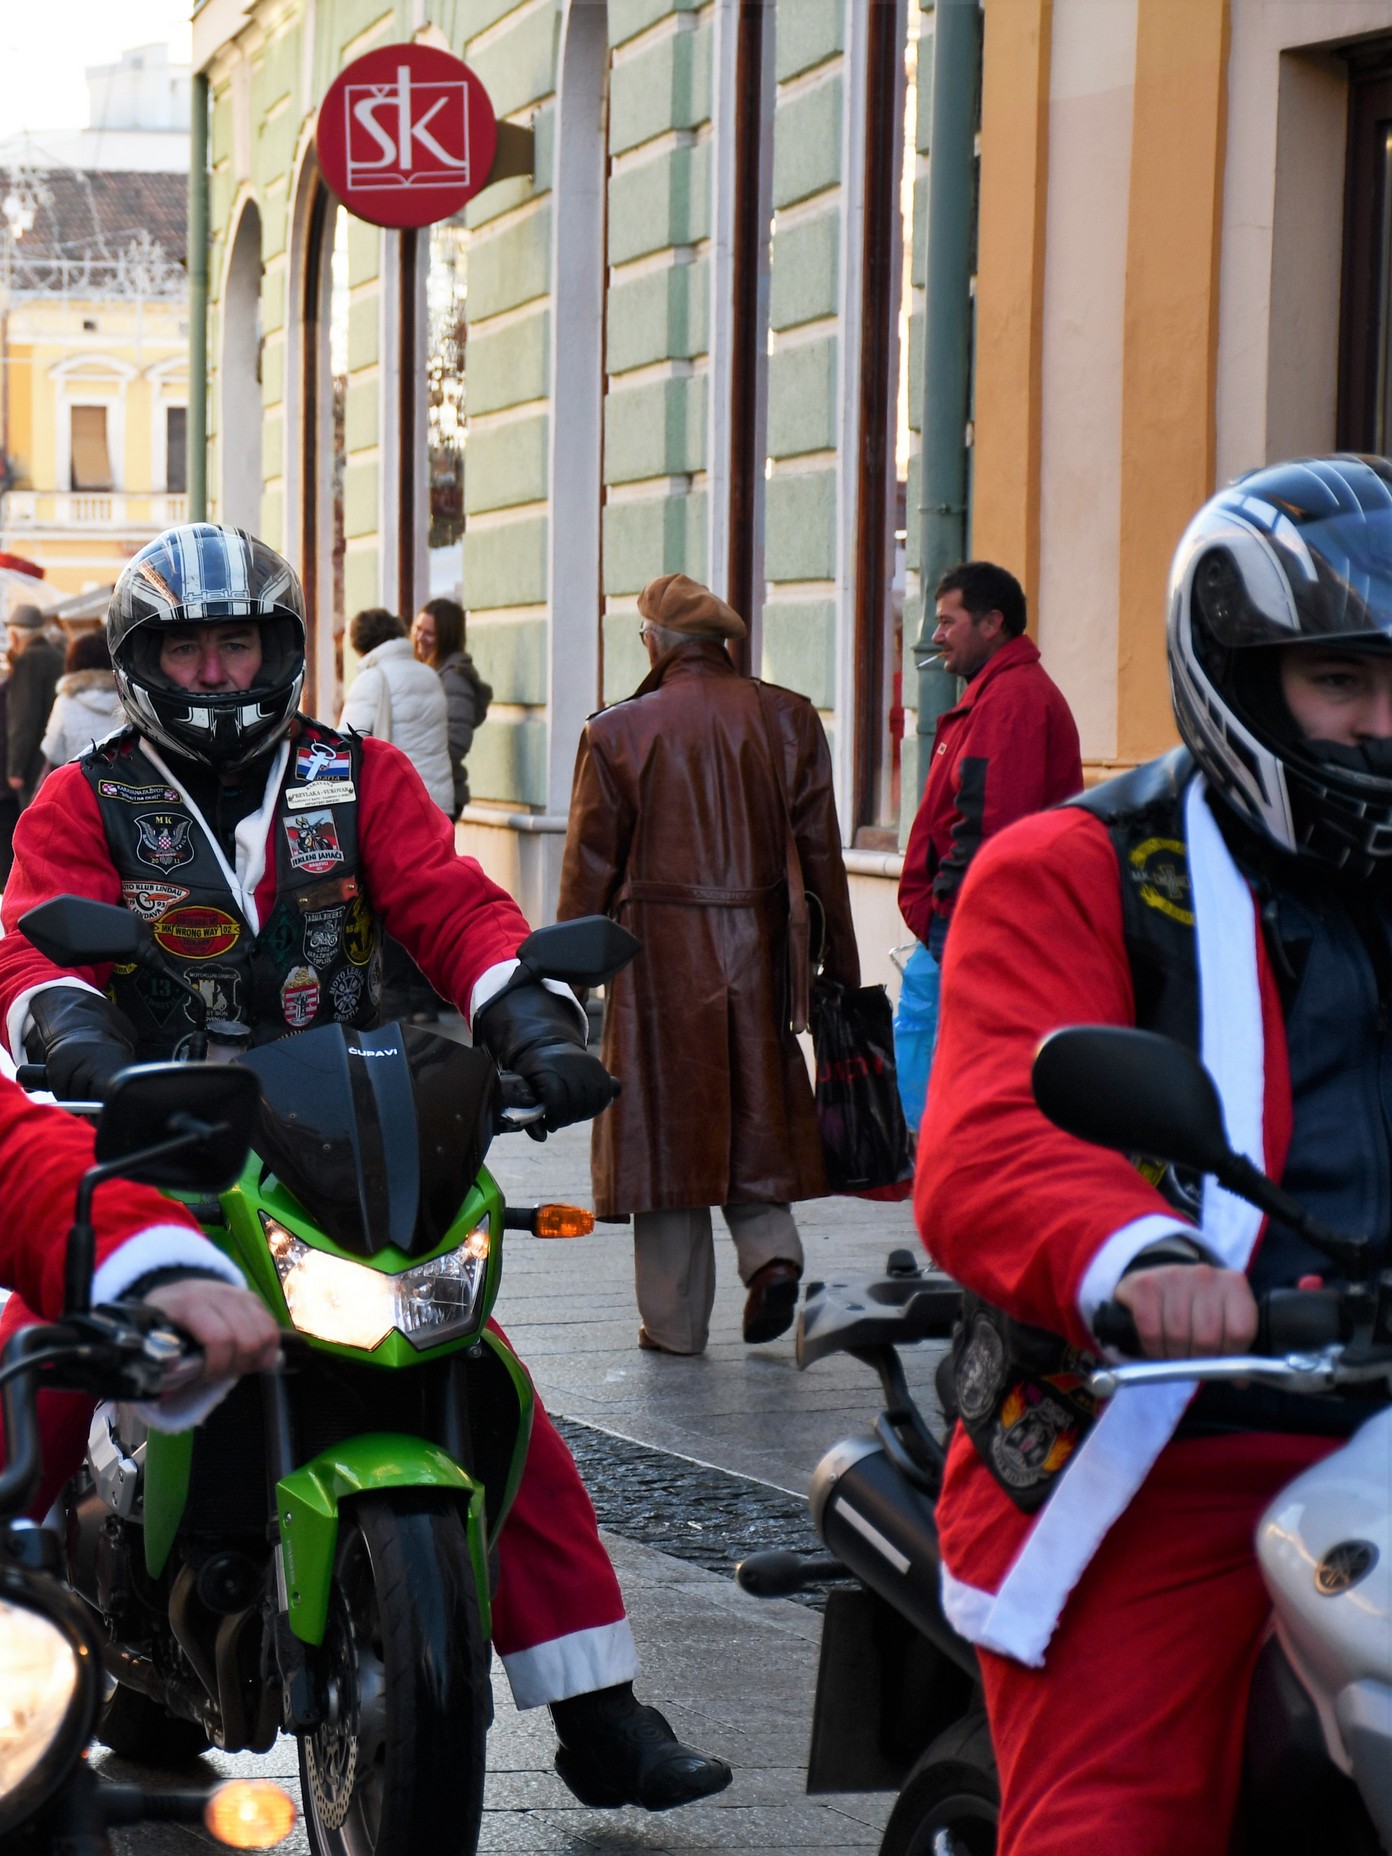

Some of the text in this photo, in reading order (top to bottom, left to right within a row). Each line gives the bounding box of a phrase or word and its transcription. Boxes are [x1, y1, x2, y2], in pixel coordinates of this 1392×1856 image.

[156, 885, 182, 896] LINDAU
[175, 927, 202, 938] WRONG
[203, 927, 219, 937] WAY
[223, 925, 232, 934] 02
[329, 971, 346, 994] MOTO
[349, 1046, 398, 1058] ČUPAVI
